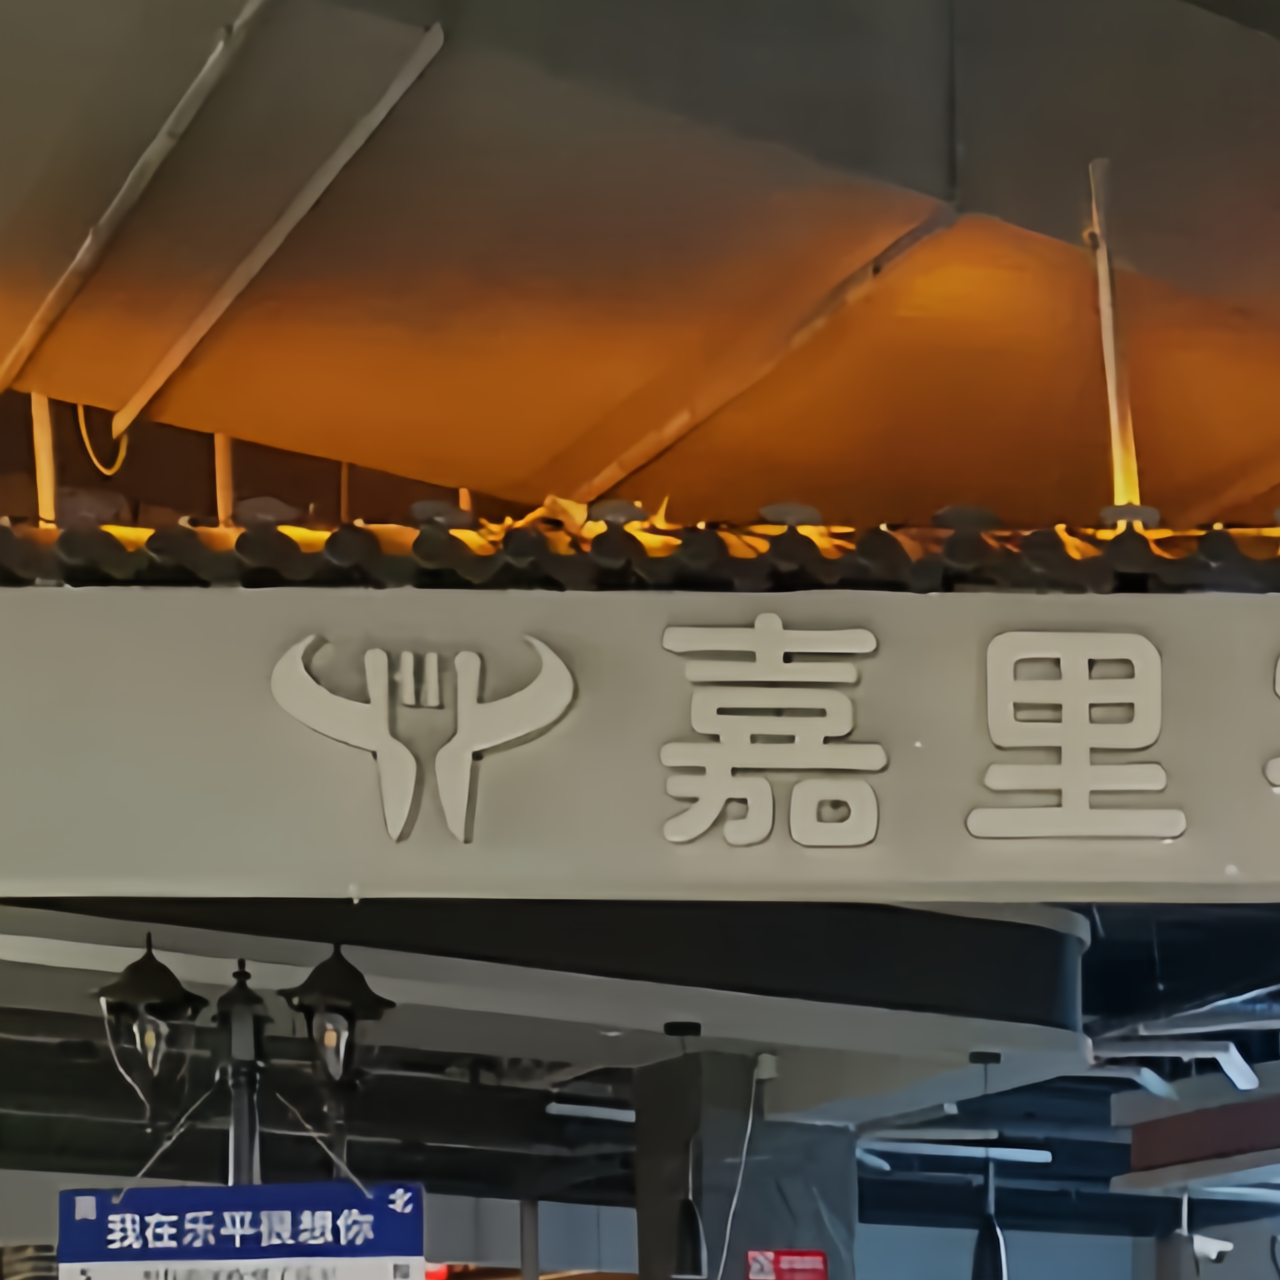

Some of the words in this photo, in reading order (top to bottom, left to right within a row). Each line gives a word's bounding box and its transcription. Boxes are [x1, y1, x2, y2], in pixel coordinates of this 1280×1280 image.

[106, 1208, 375, 1250] 我在乐平很想你
